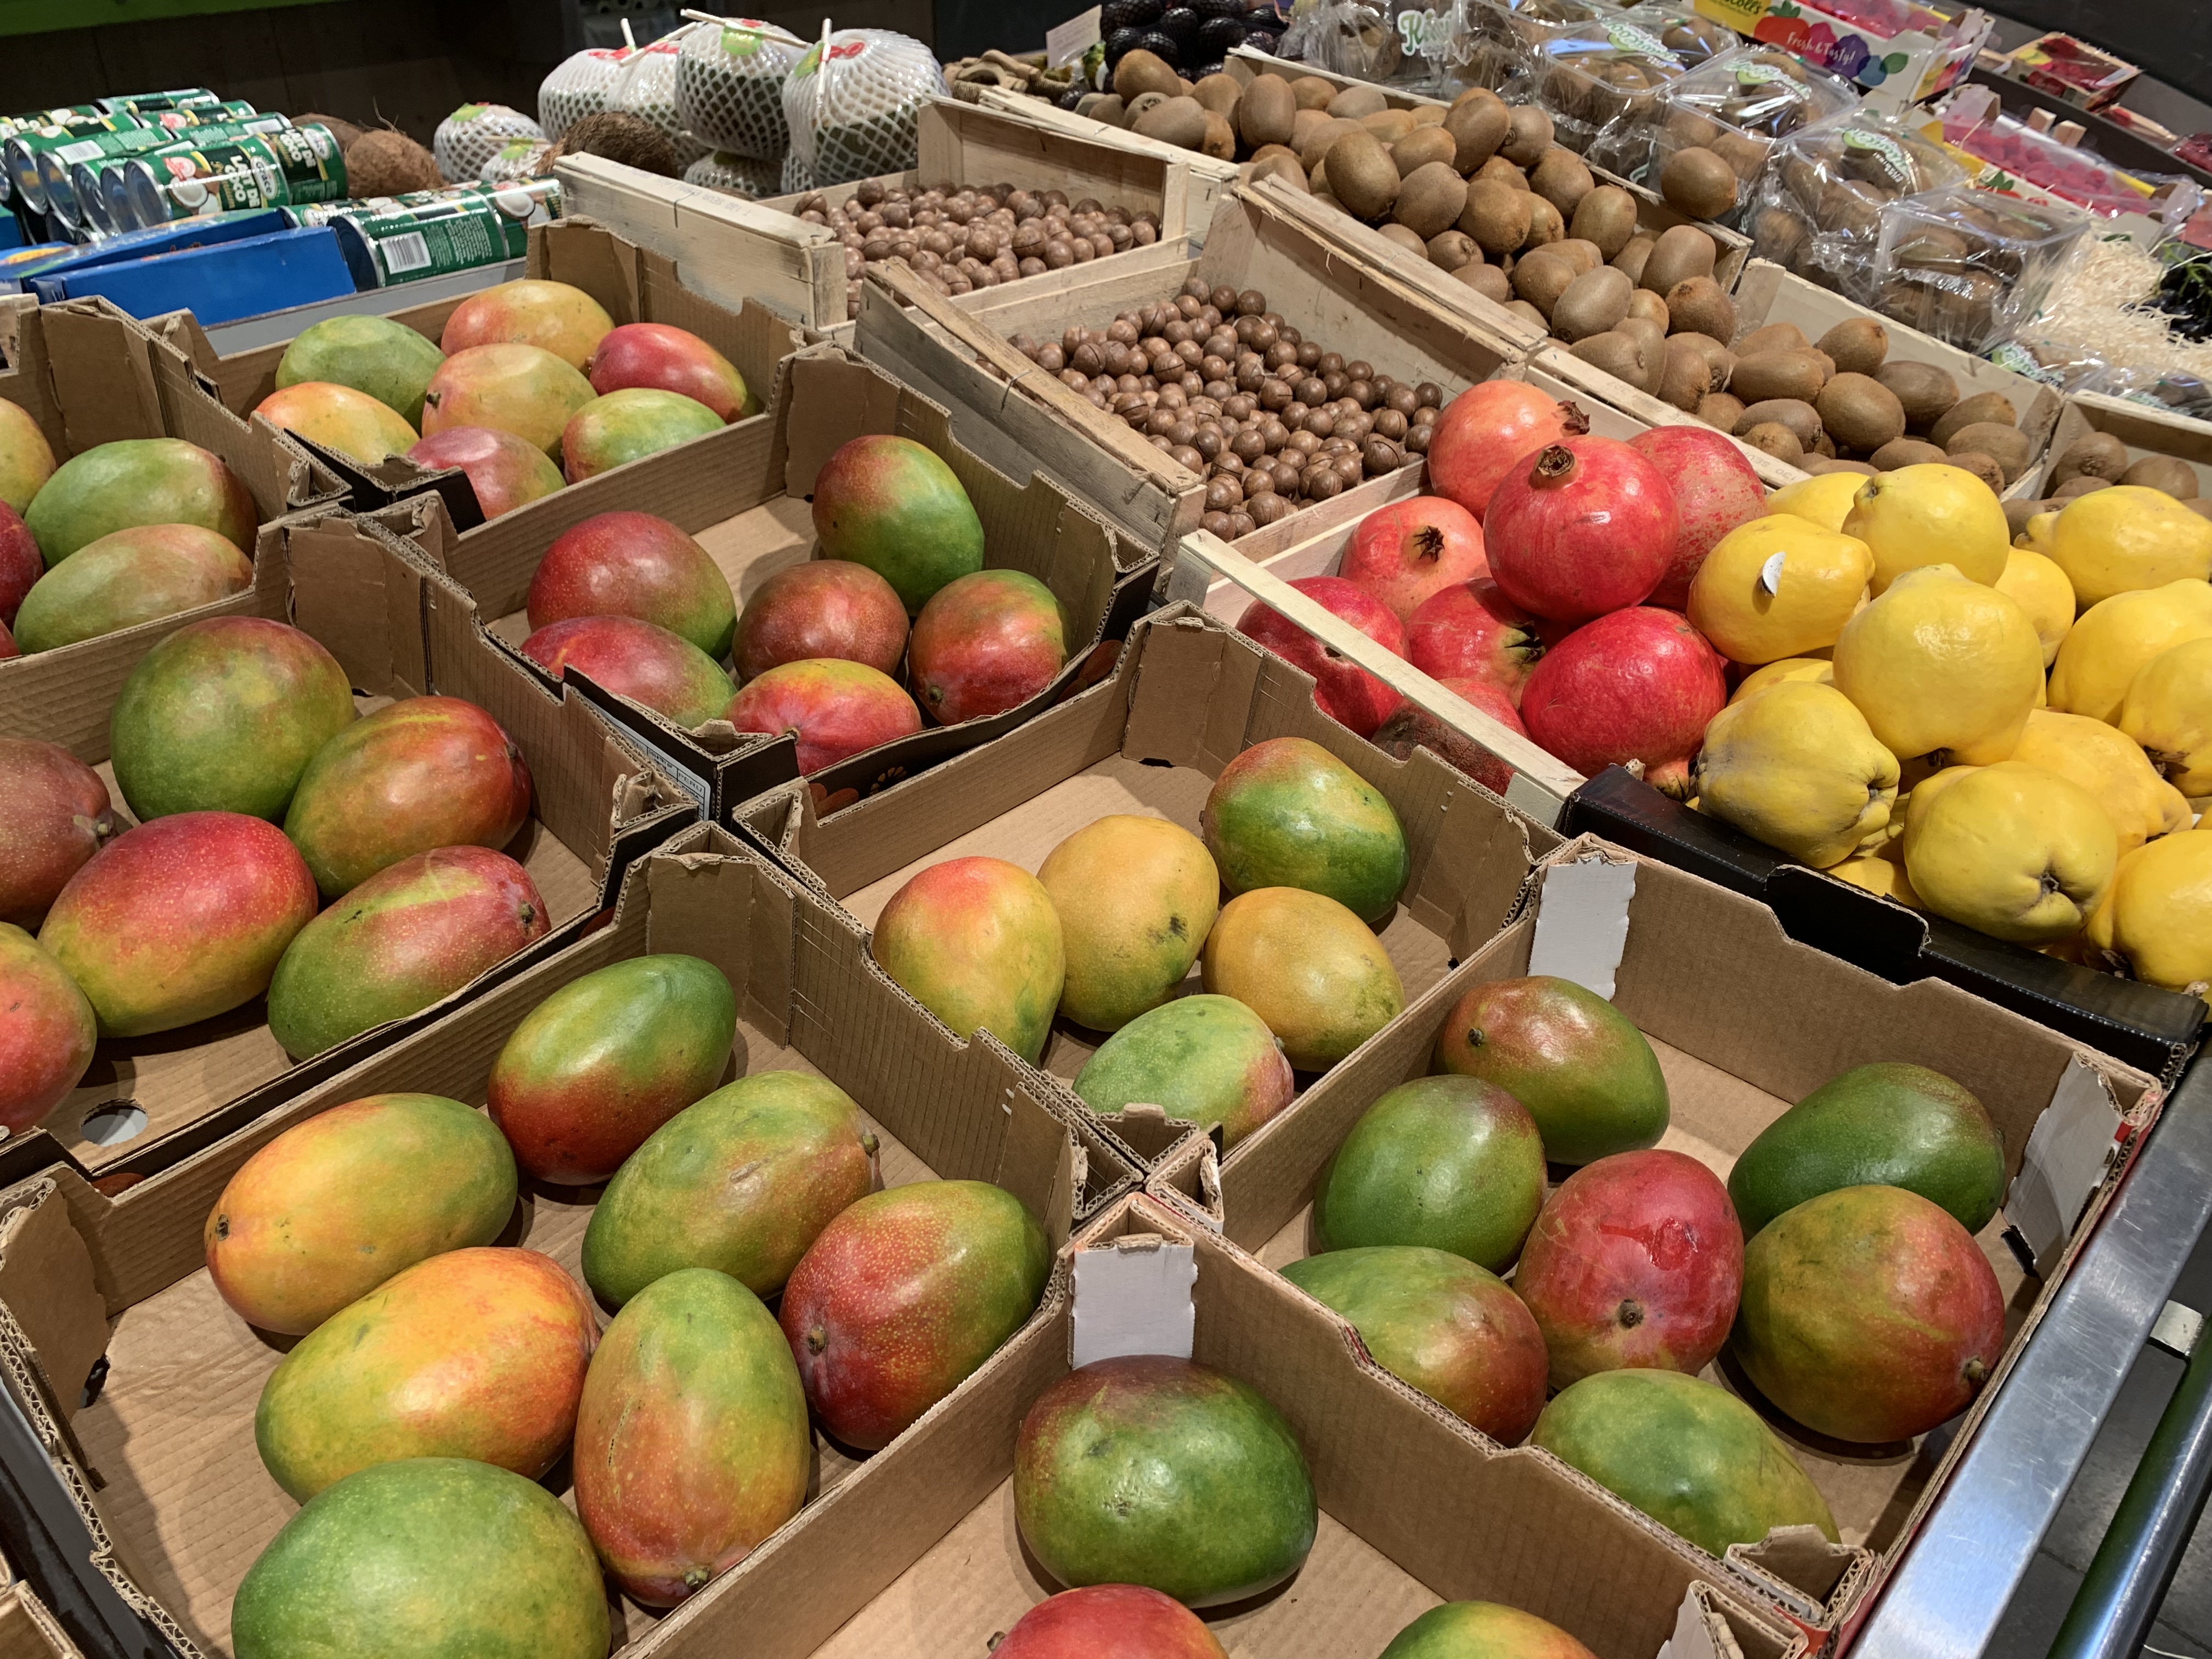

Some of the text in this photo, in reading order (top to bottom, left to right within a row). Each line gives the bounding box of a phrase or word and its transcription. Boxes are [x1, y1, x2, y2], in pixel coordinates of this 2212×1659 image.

[1787, 31, 1814, 51] Fresh
[280, 133, 302, 162] COCO
[302, 149, 317, 168] DE
[224, 165, 246, 202] COCO
[230, 155, 256, 186] LAIT
[247, 188, 261, 208] DE
[256, 161, 272, 193] Grace
[679, 772, 703, 793] PERU
